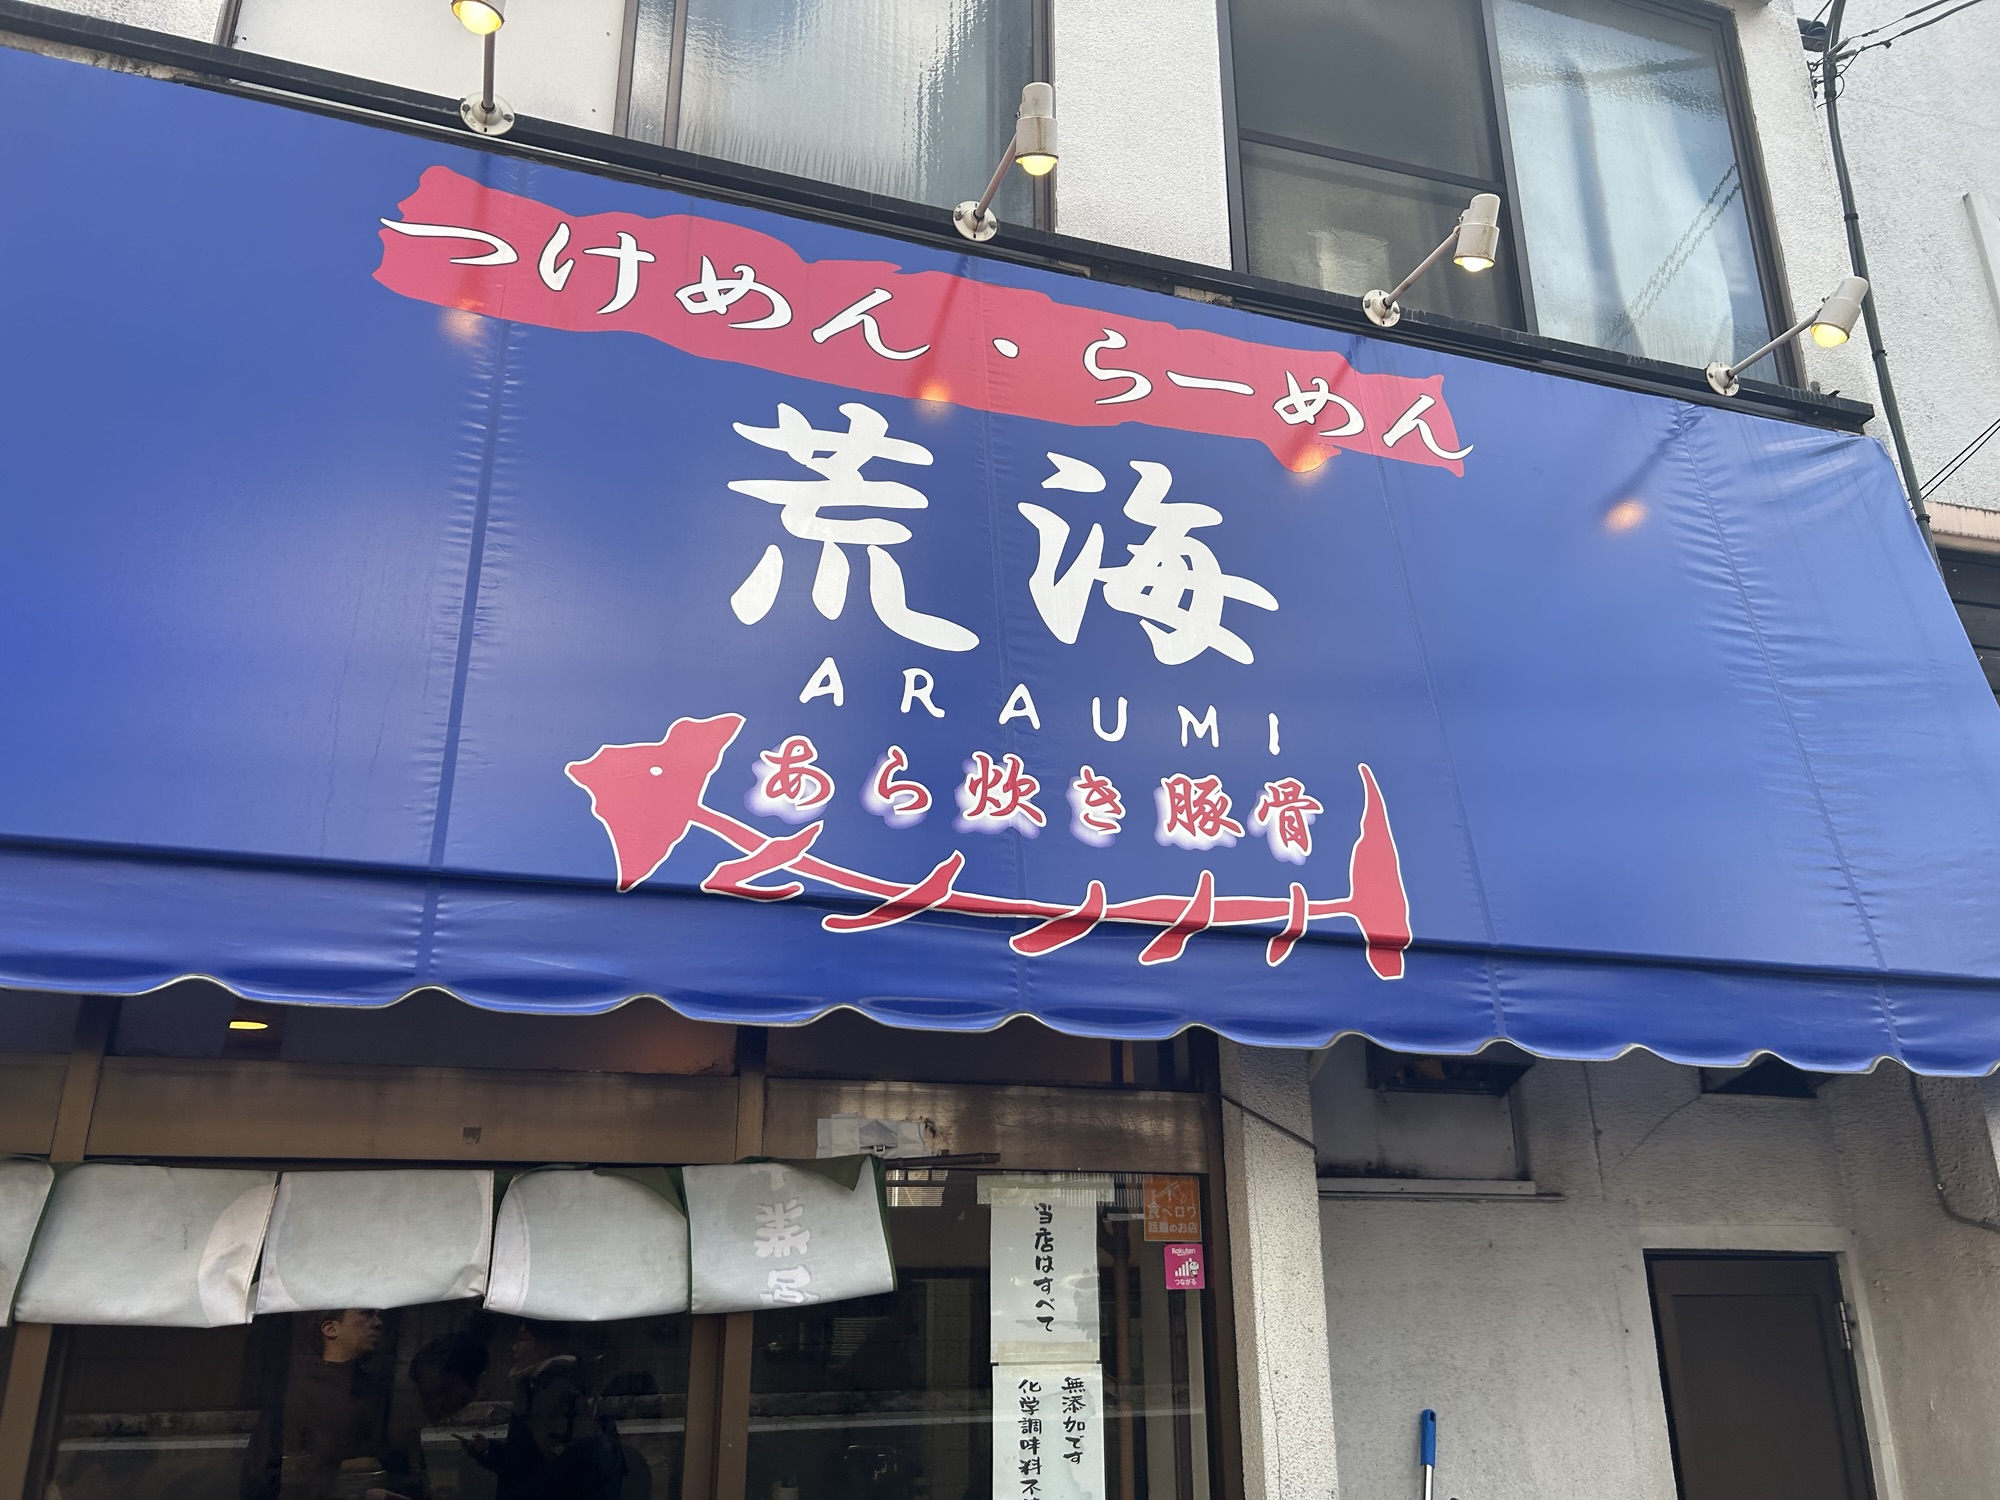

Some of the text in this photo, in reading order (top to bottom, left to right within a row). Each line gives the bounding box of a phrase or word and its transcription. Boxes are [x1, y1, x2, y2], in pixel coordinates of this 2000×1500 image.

[727, 402, 1279, 665] 荒海
[799, 656, 1281, 756] ARAUMI
[760, 734, 1324, 858] あら炊き豚骨
[1033, 1202, 1056, 1332] 当店はすべて
[1148, 1221, 1198, 1234] 話題のお店
[1171, 1247, 1196, 1256] Rakuten
[1174, 1278, 1197, 1286] つながる
[1017, 1379, 1042, 1500] 化学調味料不
[1061, 1376, 1086, 1464] 無添加です
